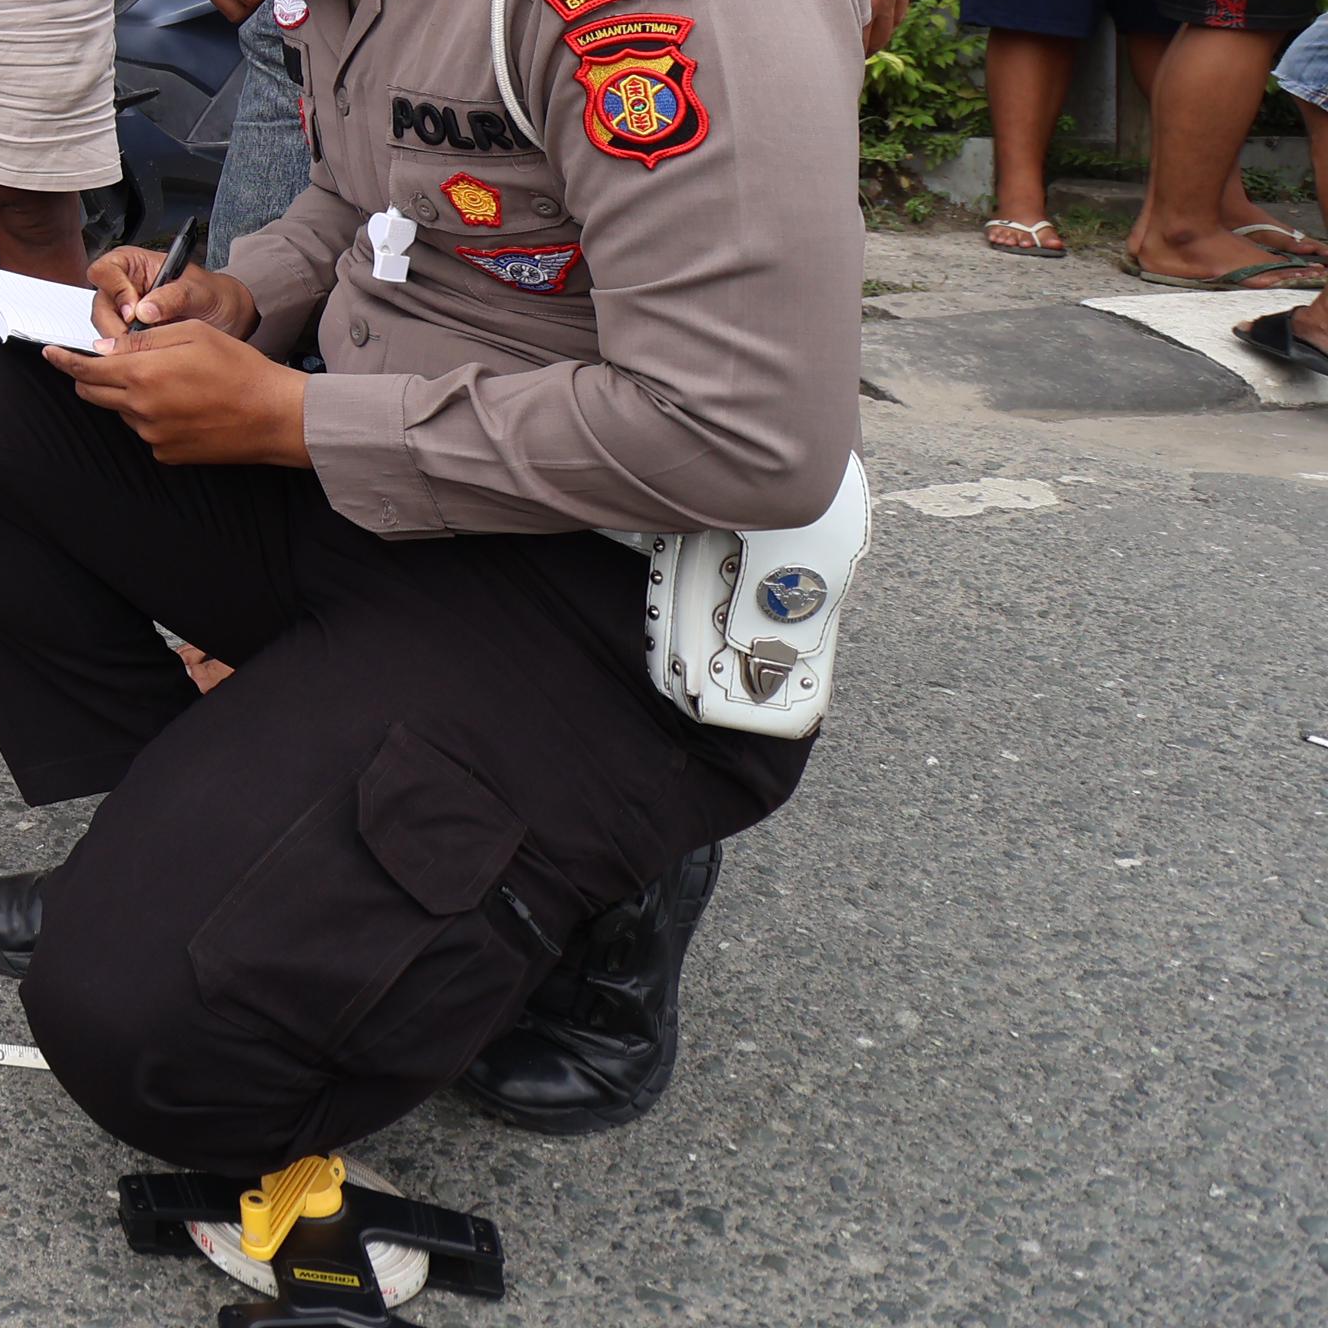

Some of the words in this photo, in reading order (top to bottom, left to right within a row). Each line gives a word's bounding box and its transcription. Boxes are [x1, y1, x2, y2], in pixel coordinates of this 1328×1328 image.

[577, 23, 642, 46] KALIMANTAN
[642, 22, 678, 35] TIMUR
[299, 1270, 355, 1285] KRISBOW
